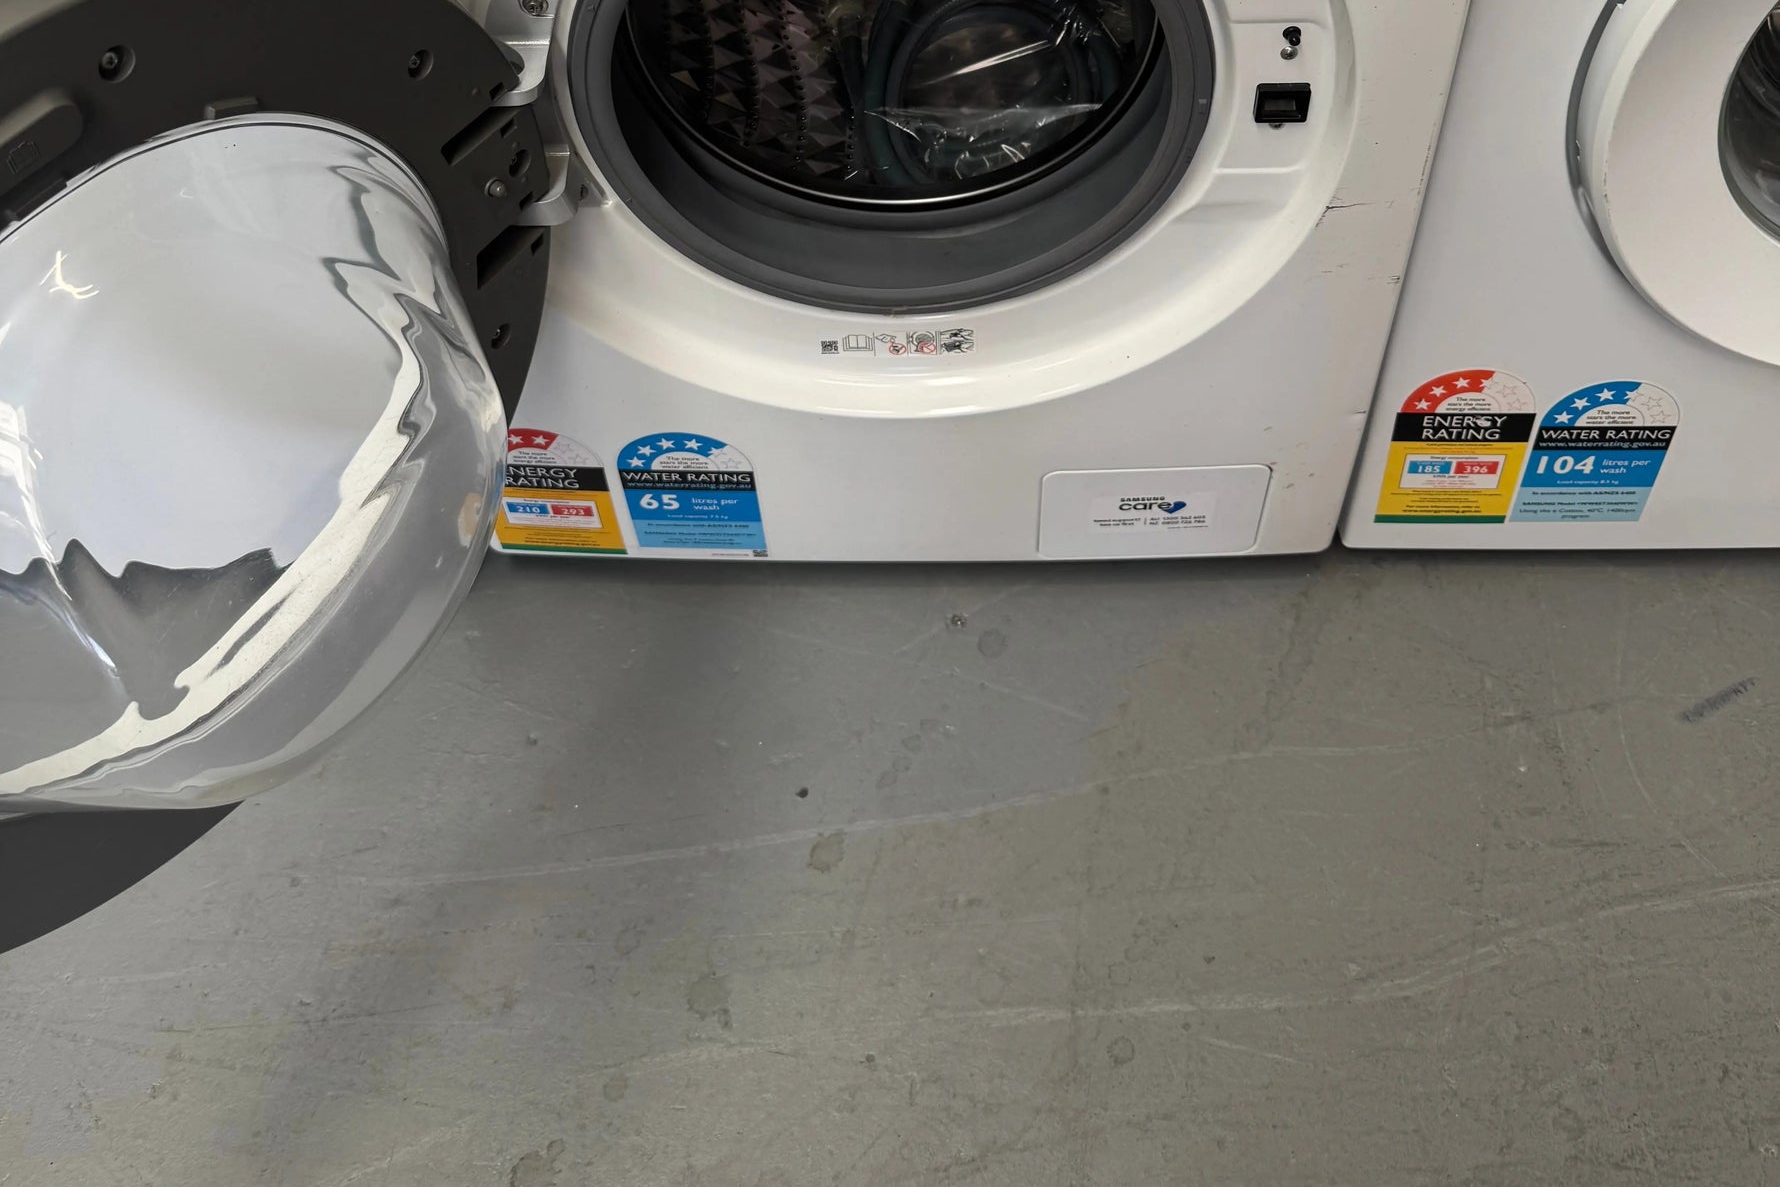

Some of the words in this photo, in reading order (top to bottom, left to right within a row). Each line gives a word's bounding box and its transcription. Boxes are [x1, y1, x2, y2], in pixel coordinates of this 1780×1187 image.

[1422, 415, 1507, 427] ENERGY
[1421, 429, 1501, 440] RATING
[1541, 430, 1600, 439] WATER
[1605, 430, 1671, 439] RATING
[1536, 456, 1596, 474] 104
[507, 466, 577, 478] NERGY
[623, 472, 683, 482] WATER
[687, 472, 751, 482] RATING
[505, 476, 580, 488] RATING
[627, 482, 751, 490] www.waterrating.gov.au
[640, 494, 680, 510] 65
[1119, 502, 1172, 511] care
[518, 505, 541, 513] 210
